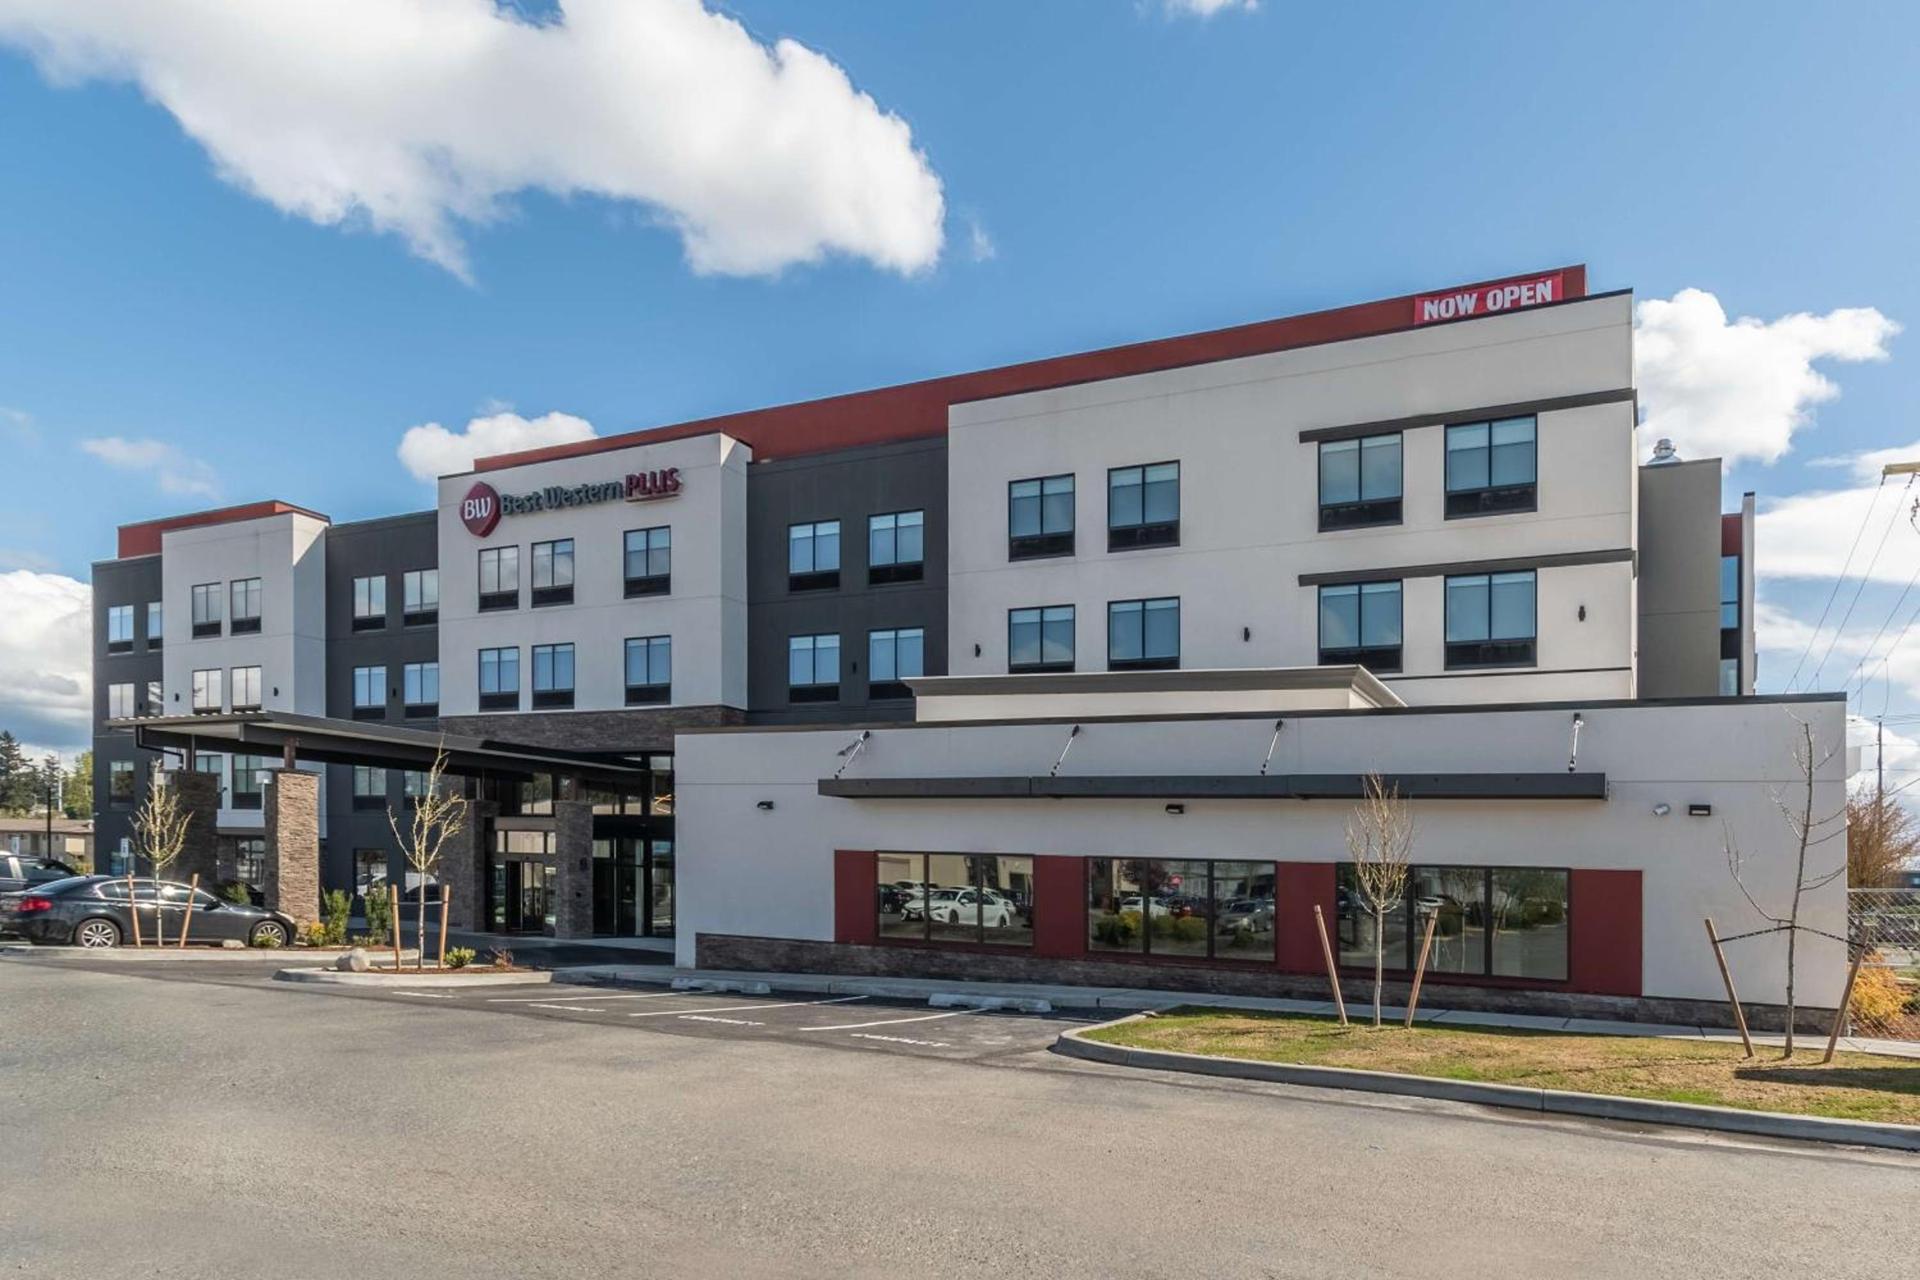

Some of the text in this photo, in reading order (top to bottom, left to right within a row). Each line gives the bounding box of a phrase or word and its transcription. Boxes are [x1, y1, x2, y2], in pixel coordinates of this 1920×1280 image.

[1423, 279, 1553, 321] NOW OPEN
[464, 497, 491, 520] BW
[501, 467, 682, 516] Best Western PLUS
